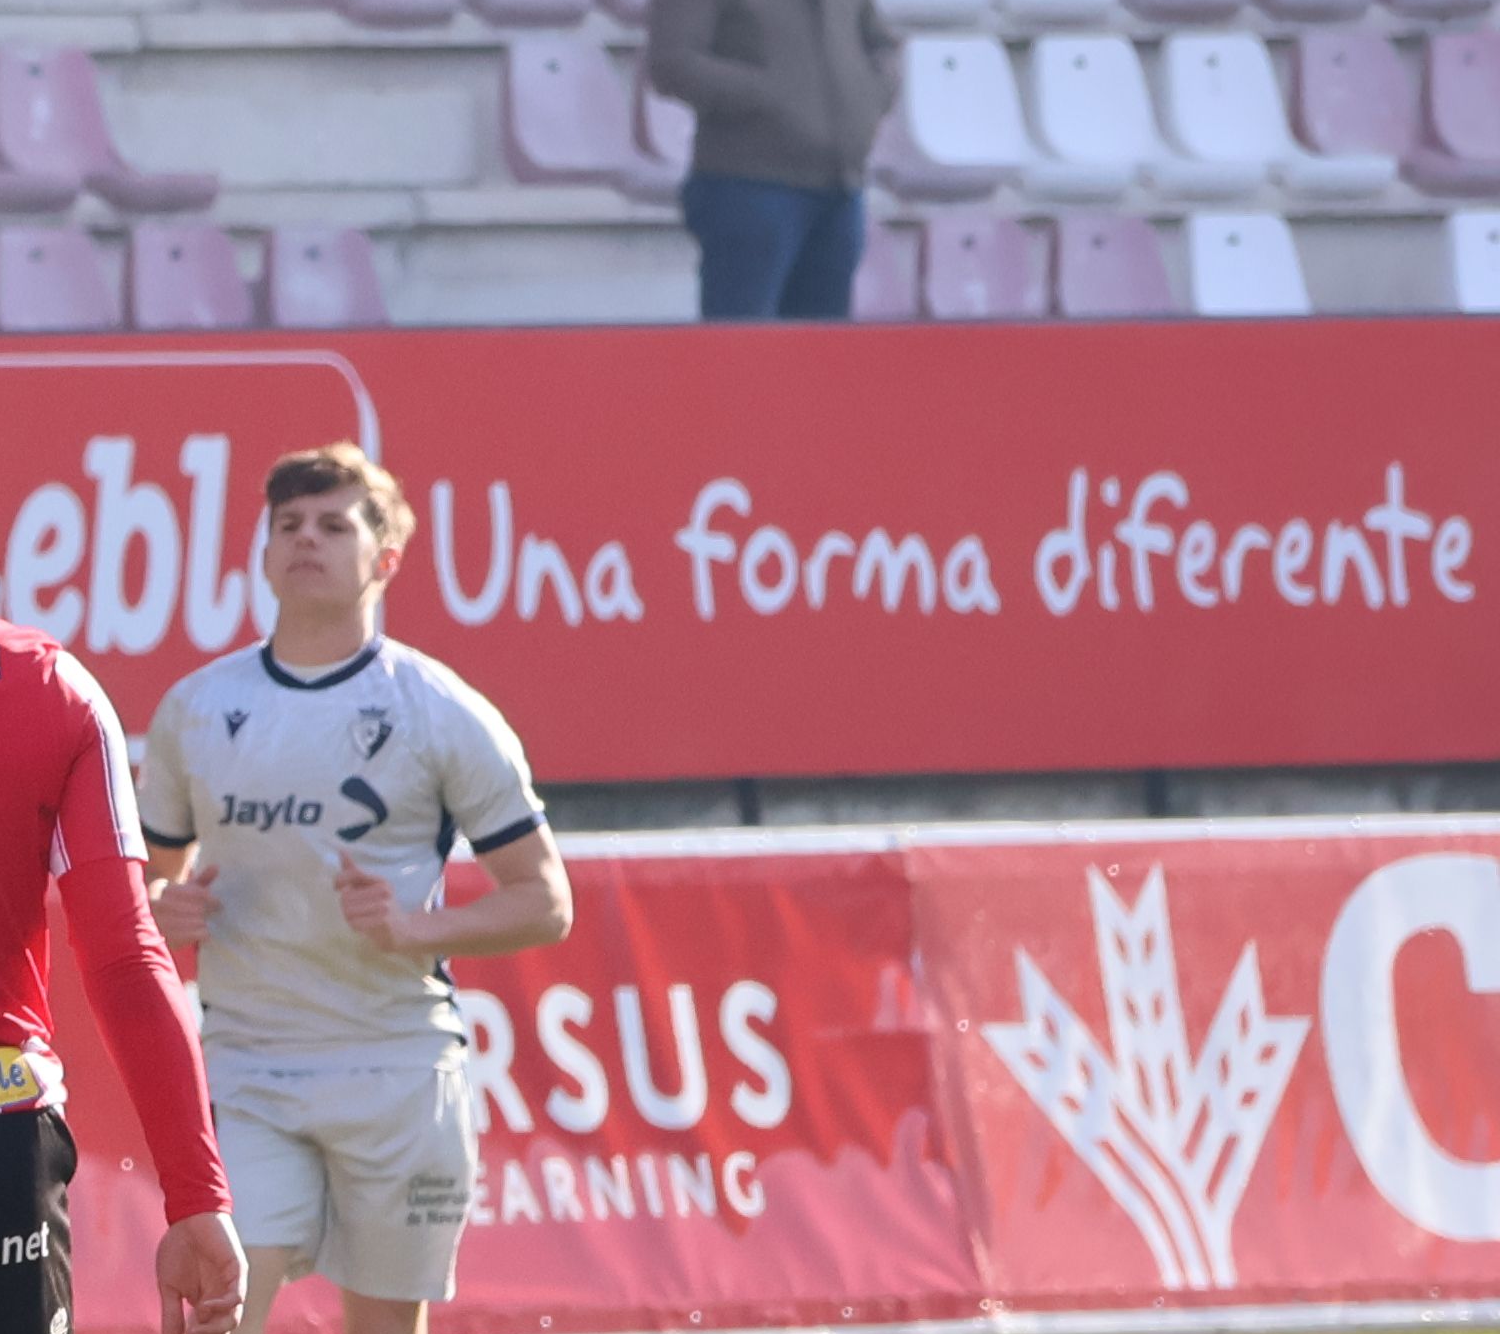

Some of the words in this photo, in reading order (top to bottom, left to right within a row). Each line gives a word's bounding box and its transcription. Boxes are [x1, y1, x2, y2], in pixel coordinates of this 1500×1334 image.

[430, 479, 644, 627] Una
[676, 477, 1001, 621] forma
[1032, 462, 1476, 617] diferente
[458, 979, 793, 1135] RSUS
[470, 1149, 768, 1227] EARNING
